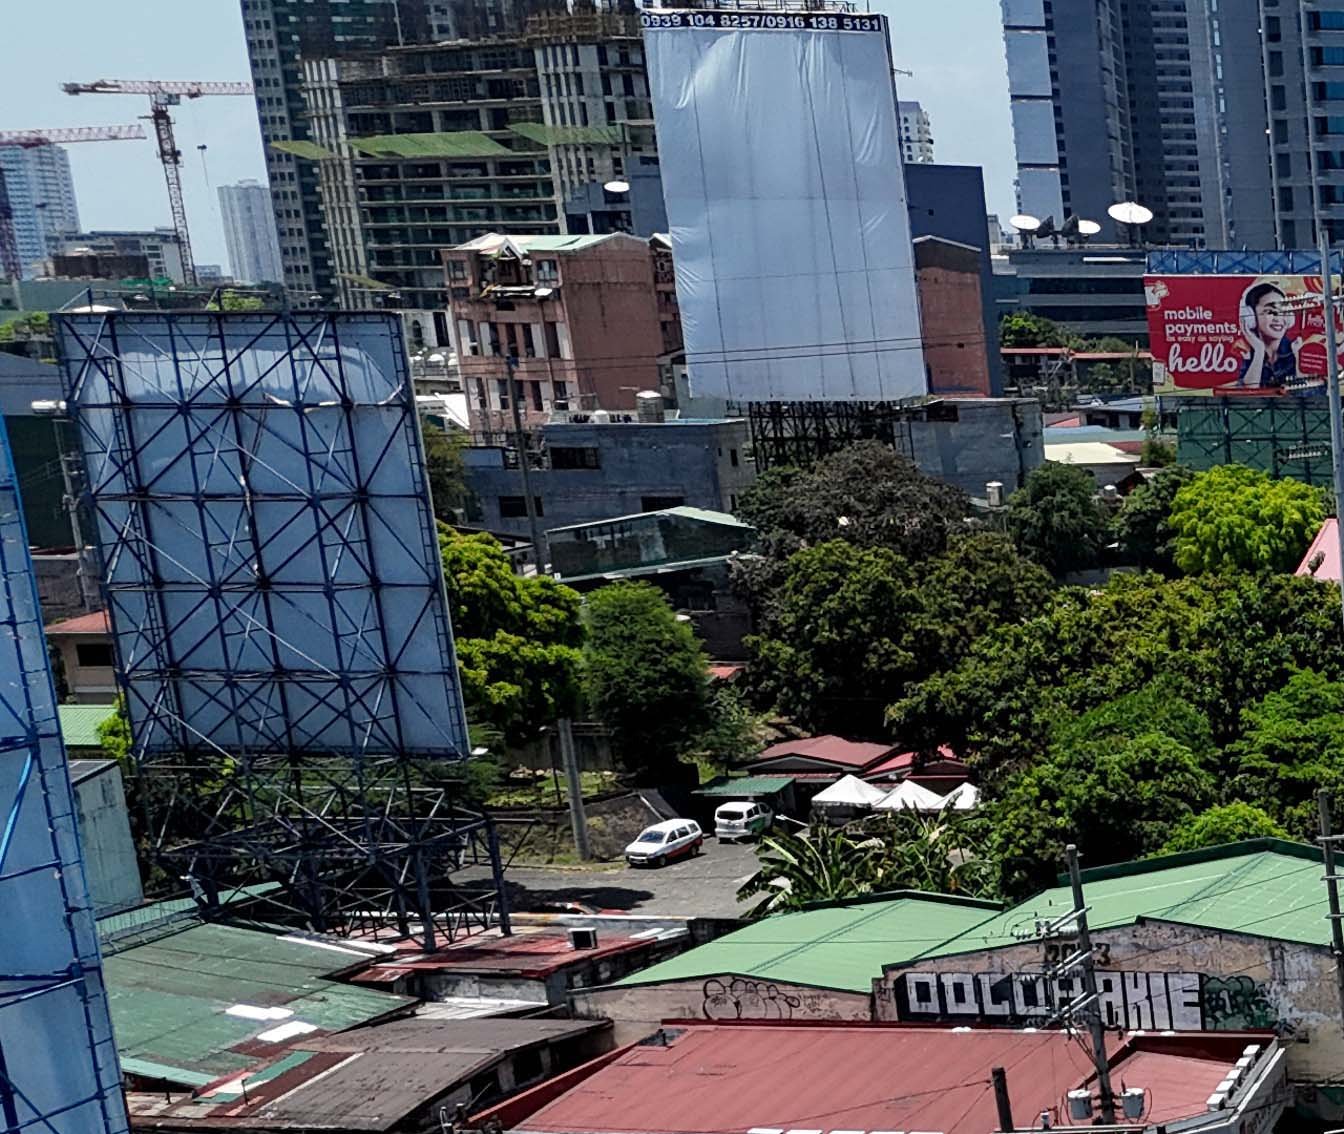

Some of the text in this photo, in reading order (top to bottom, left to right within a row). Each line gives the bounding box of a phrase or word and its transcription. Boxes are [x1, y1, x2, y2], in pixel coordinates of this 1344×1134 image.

[640, 15, 879, 31] 0939 104 8257/0916 138 5131
[1164, 307, 1213, 320] mobile
[1165, 321, 1241, 337] payments,
[1169, 343, 1238, 373] hello
